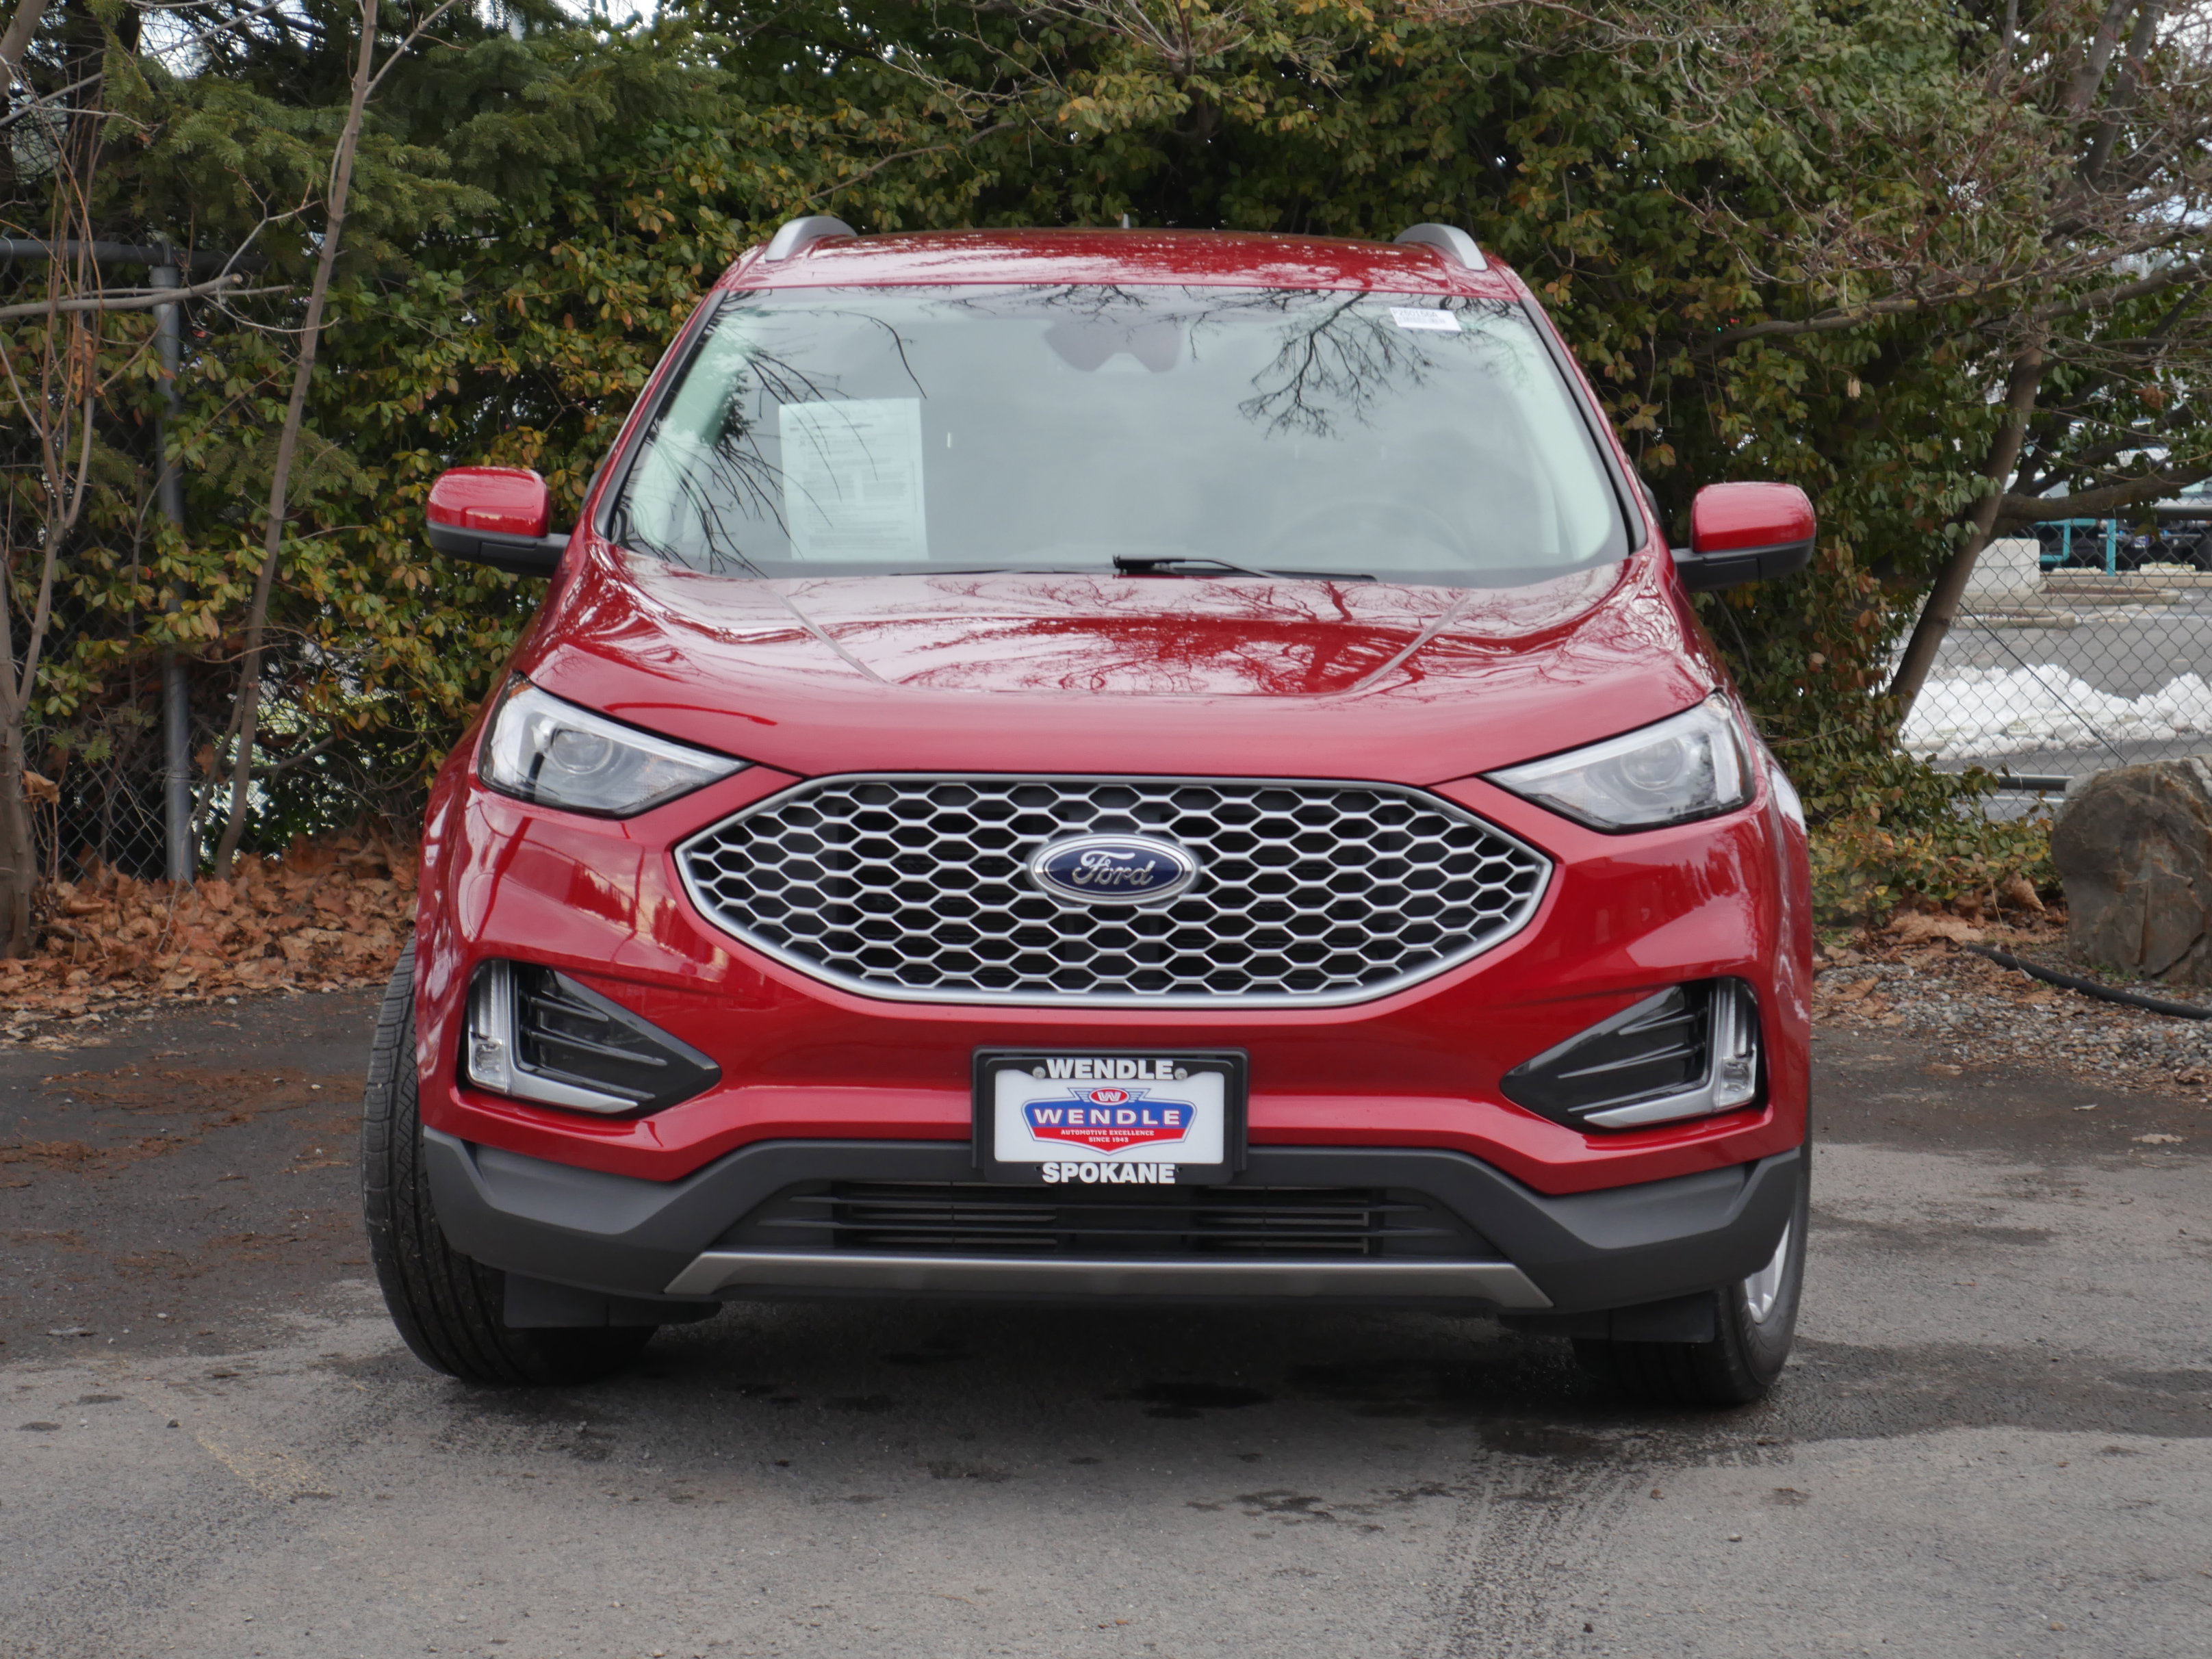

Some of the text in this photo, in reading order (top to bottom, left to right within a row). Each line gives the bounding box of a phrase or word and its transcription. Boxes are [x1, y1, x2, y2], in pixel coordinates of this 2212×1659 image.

[1071, 850, 1156, 886] Ford
[1046, 1058, 1174, 1080] WENDLE
[1034, 1109, 1181, 1125] WENDLE
[1042, 1162, 1176, 1184] SPOKANE
